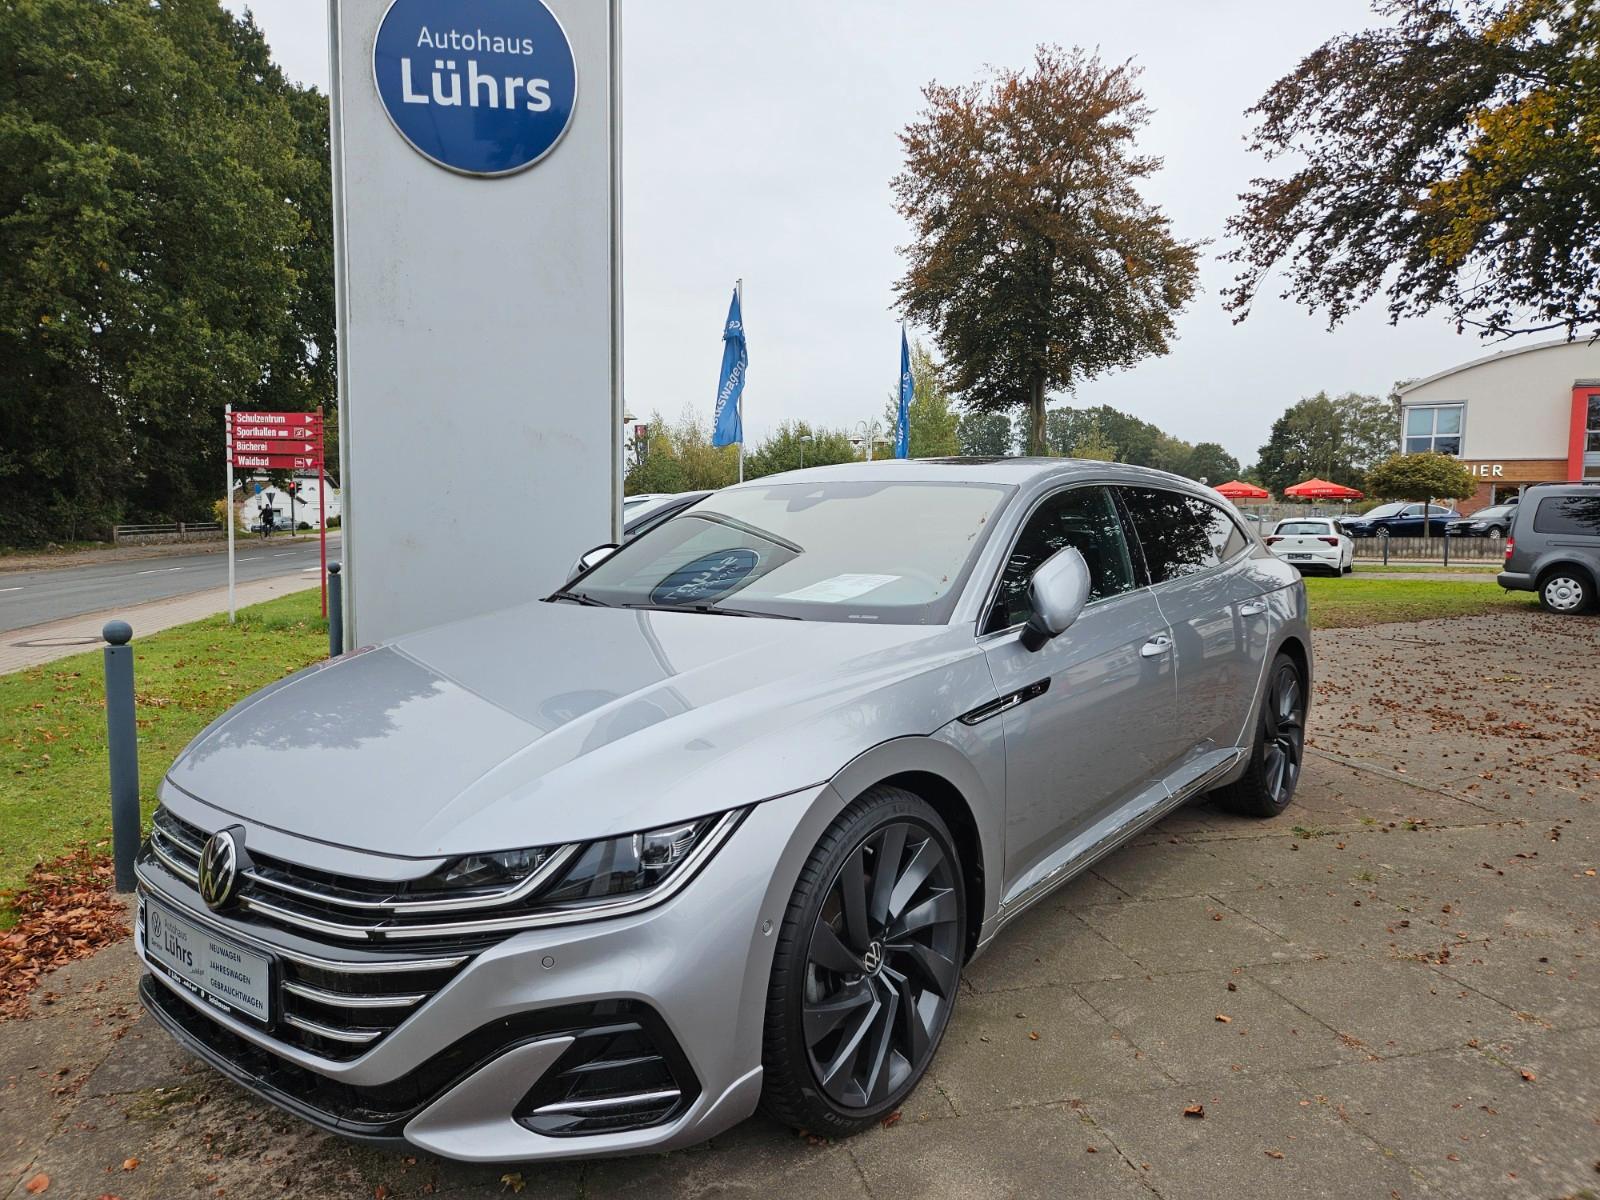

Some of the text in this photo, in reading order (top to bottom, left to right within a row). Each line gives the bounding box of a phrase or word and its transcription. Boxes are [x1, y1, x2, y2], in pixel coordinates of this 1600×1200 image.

[416, 26, 534, 56] Autohaus
[401, 57, 552, 112] Lührs
[236, 414, 286, 424] Schulzentrum
[236, 426, 277, 438] Sporthallen
[236, 441, 268, 451] Bücherei
[238, 455, 270, 466] Waldbad
[164, 919, 188, 941] Autohaus
[164, 931, 193, 967] Lührs
[209, 942, 242, 963] NEUWAGEN
[209, 960, 251, 985] JAHRESWAGEN
[210, 978, 264, 1010] GEBRAUCHTWAGEN
